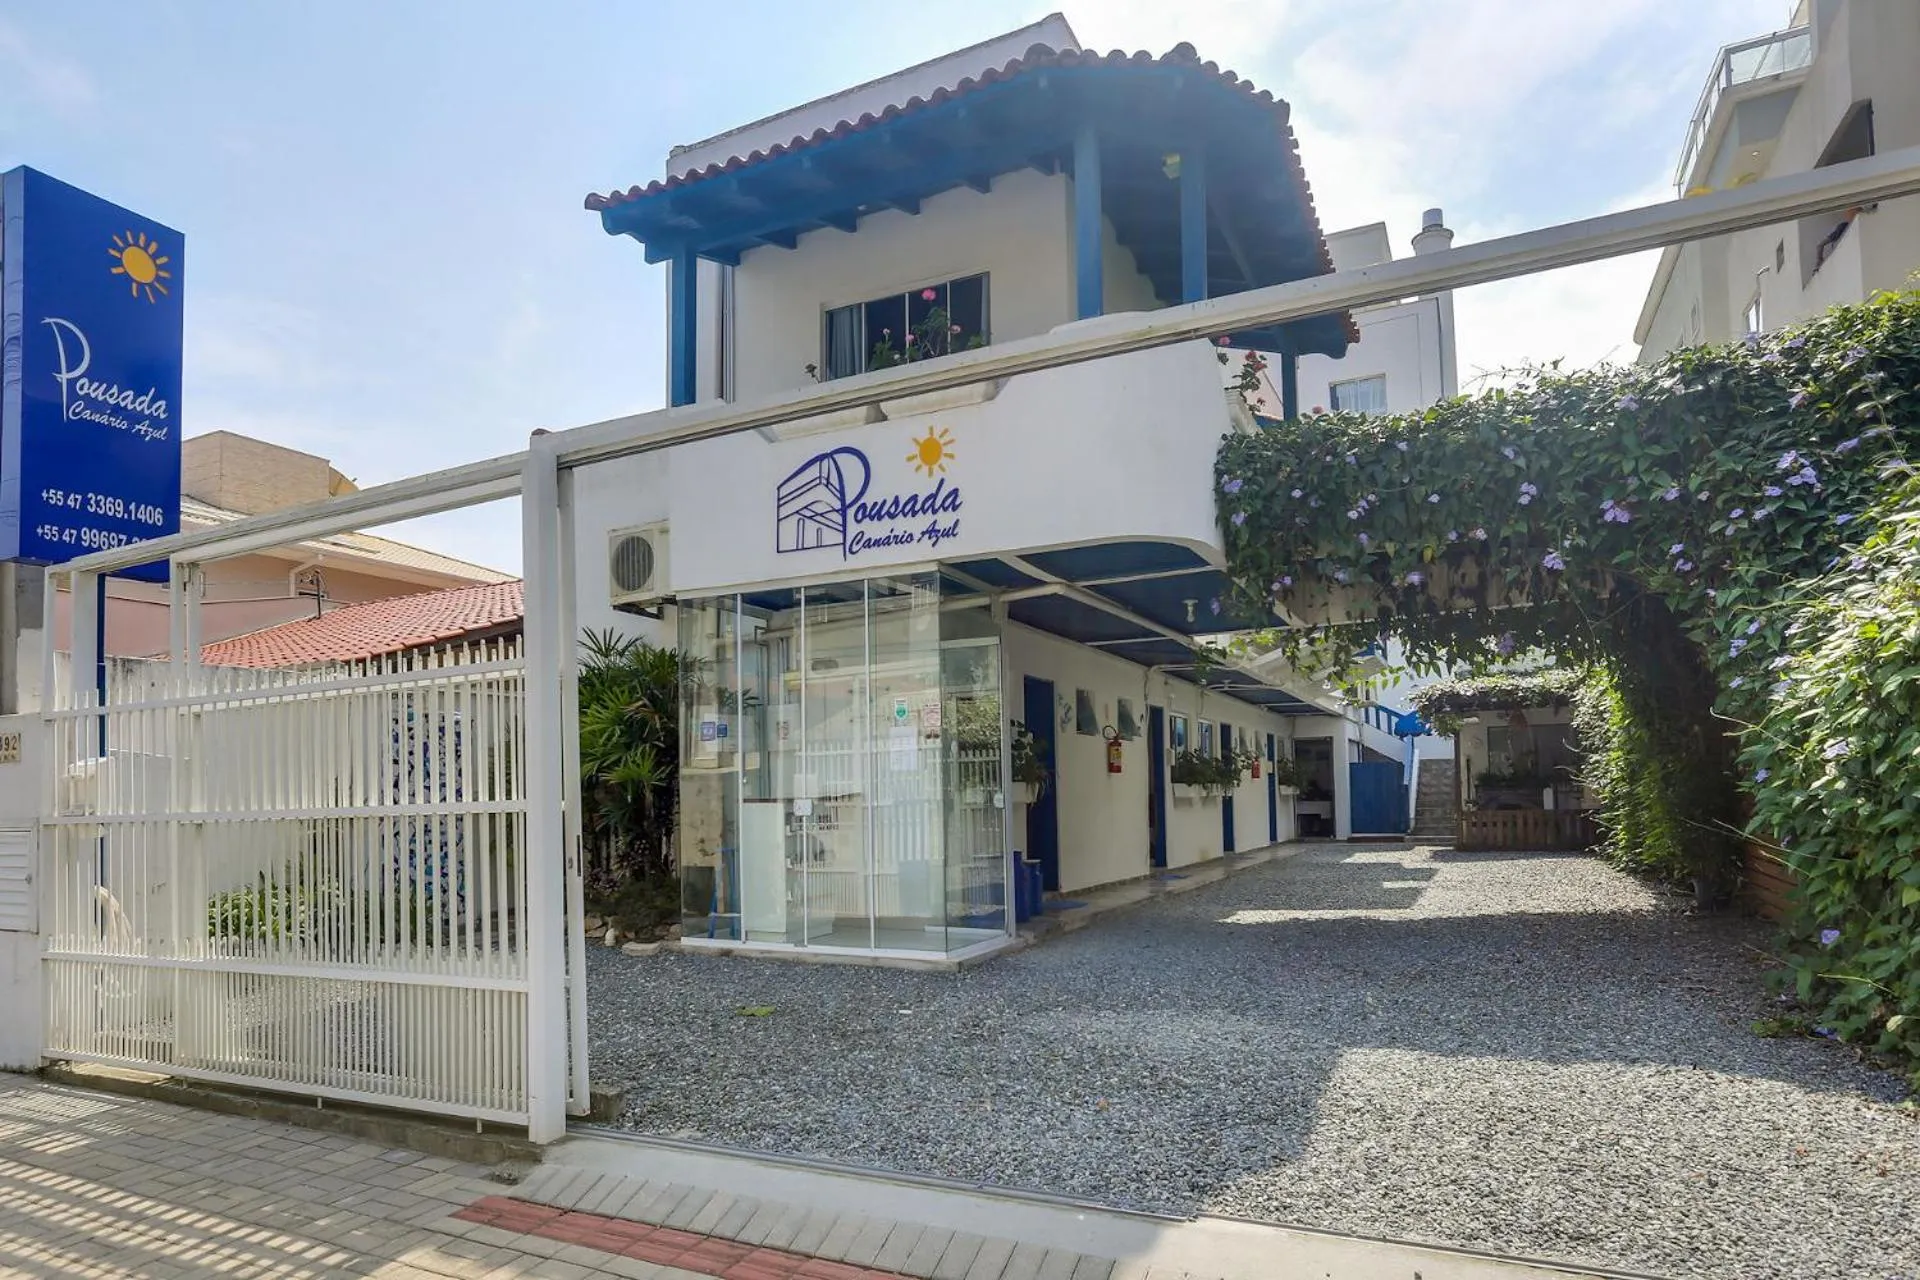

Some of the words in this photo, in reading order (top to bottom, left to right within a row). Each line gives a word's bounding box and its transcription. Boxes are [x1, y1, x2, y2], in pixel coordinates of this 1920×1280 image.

[41, 317, 168, 422] Pousada
[69, 400, 128, 430] Canário
[132, 419, 168, 441] Azul
[42, 488, 64, 506] +55
[67, 493, 82, 510] 47
[87, 493, 163, 526] 3369.1406
[824, 446, 963, 562] Pousada
[37, 525, 59, 542] +55
[62, 528, 77, 545] 47
[81, 527, 147, 549] 99697
[848, 528, 914, 555] Canário
[917, 518, 960, 547] Azul
